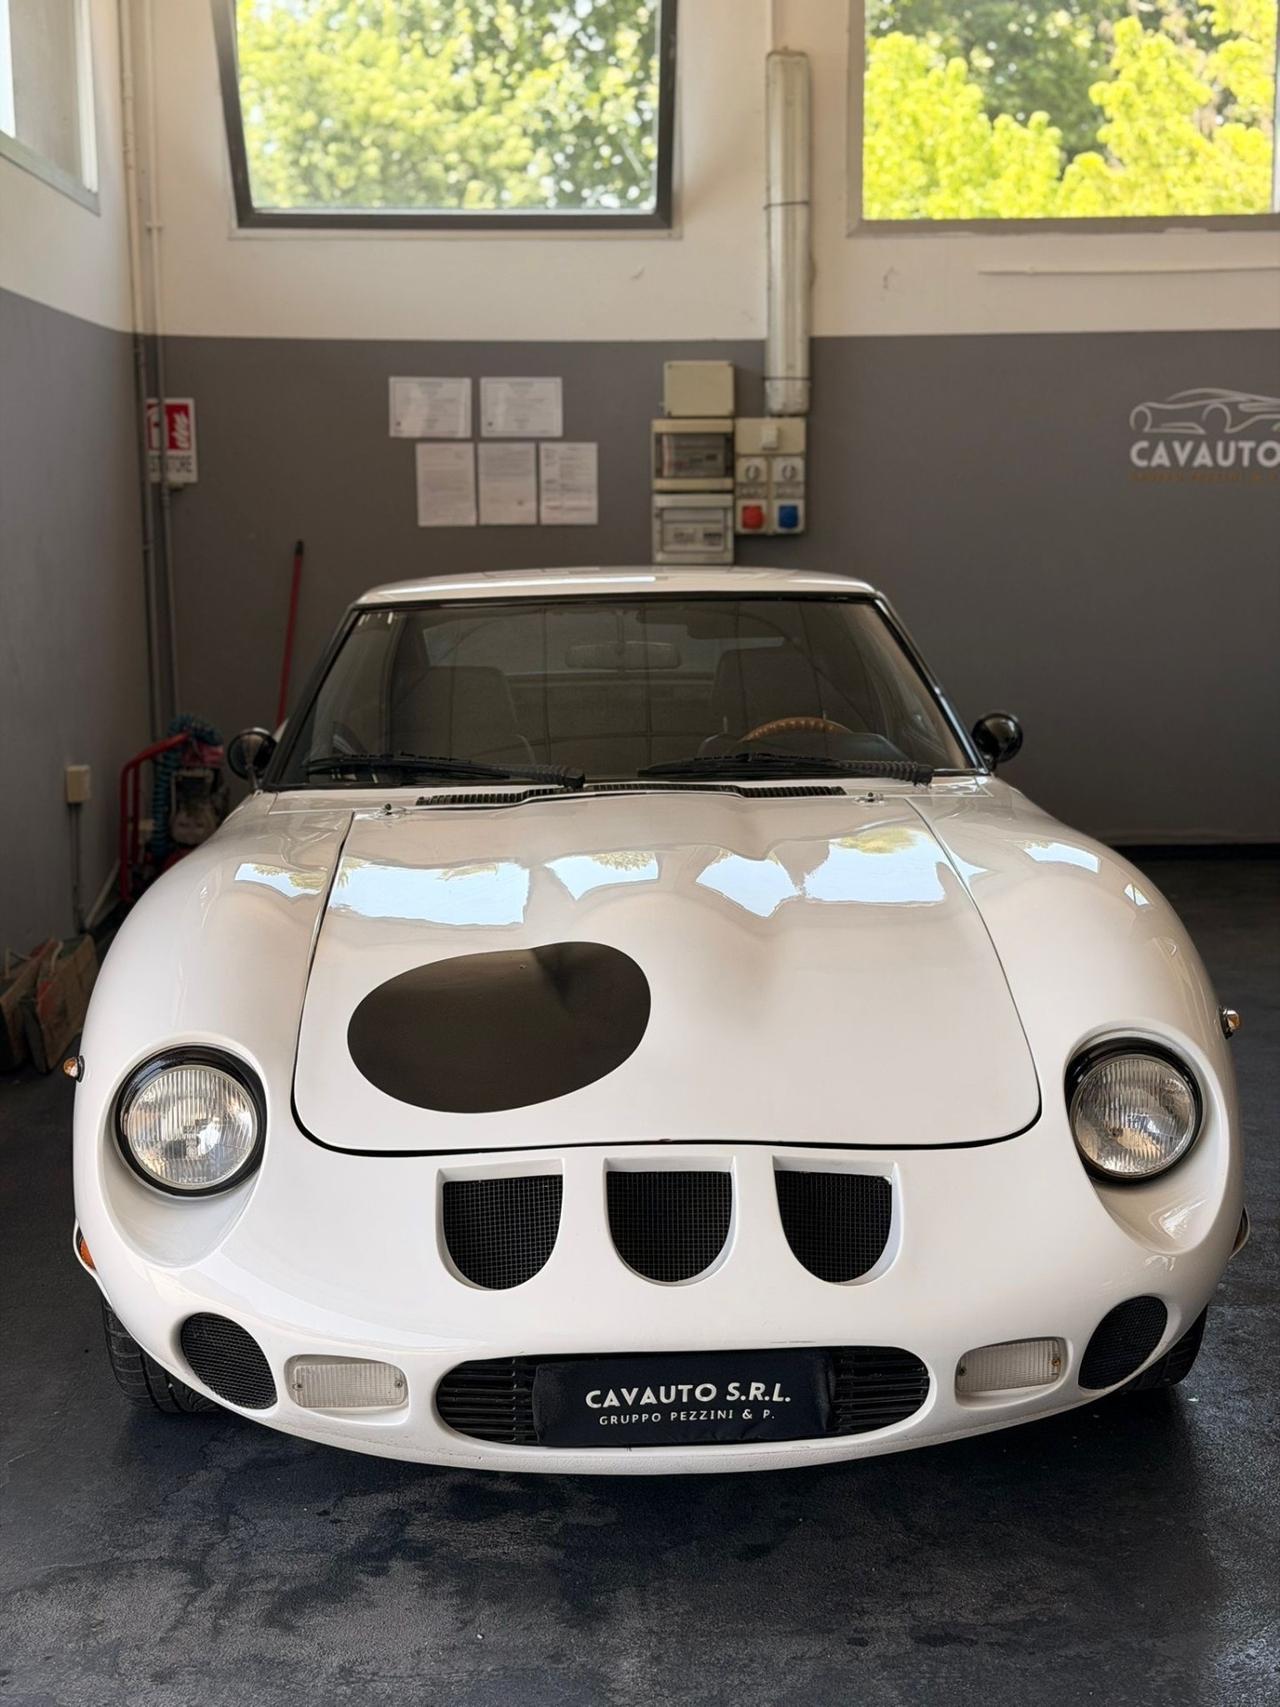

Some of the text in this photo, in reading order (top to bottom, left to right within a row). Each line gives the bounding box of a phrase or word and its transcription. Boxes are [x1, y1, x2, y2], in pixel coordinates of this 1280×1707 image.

[1130, 440, 1280, 468] CAVAUTO
[585, 1382, 791, 1408] CAVAUTO S.R.L.
[599, 1408, 775, 1425] GRUPPO PEZZINI & P.
